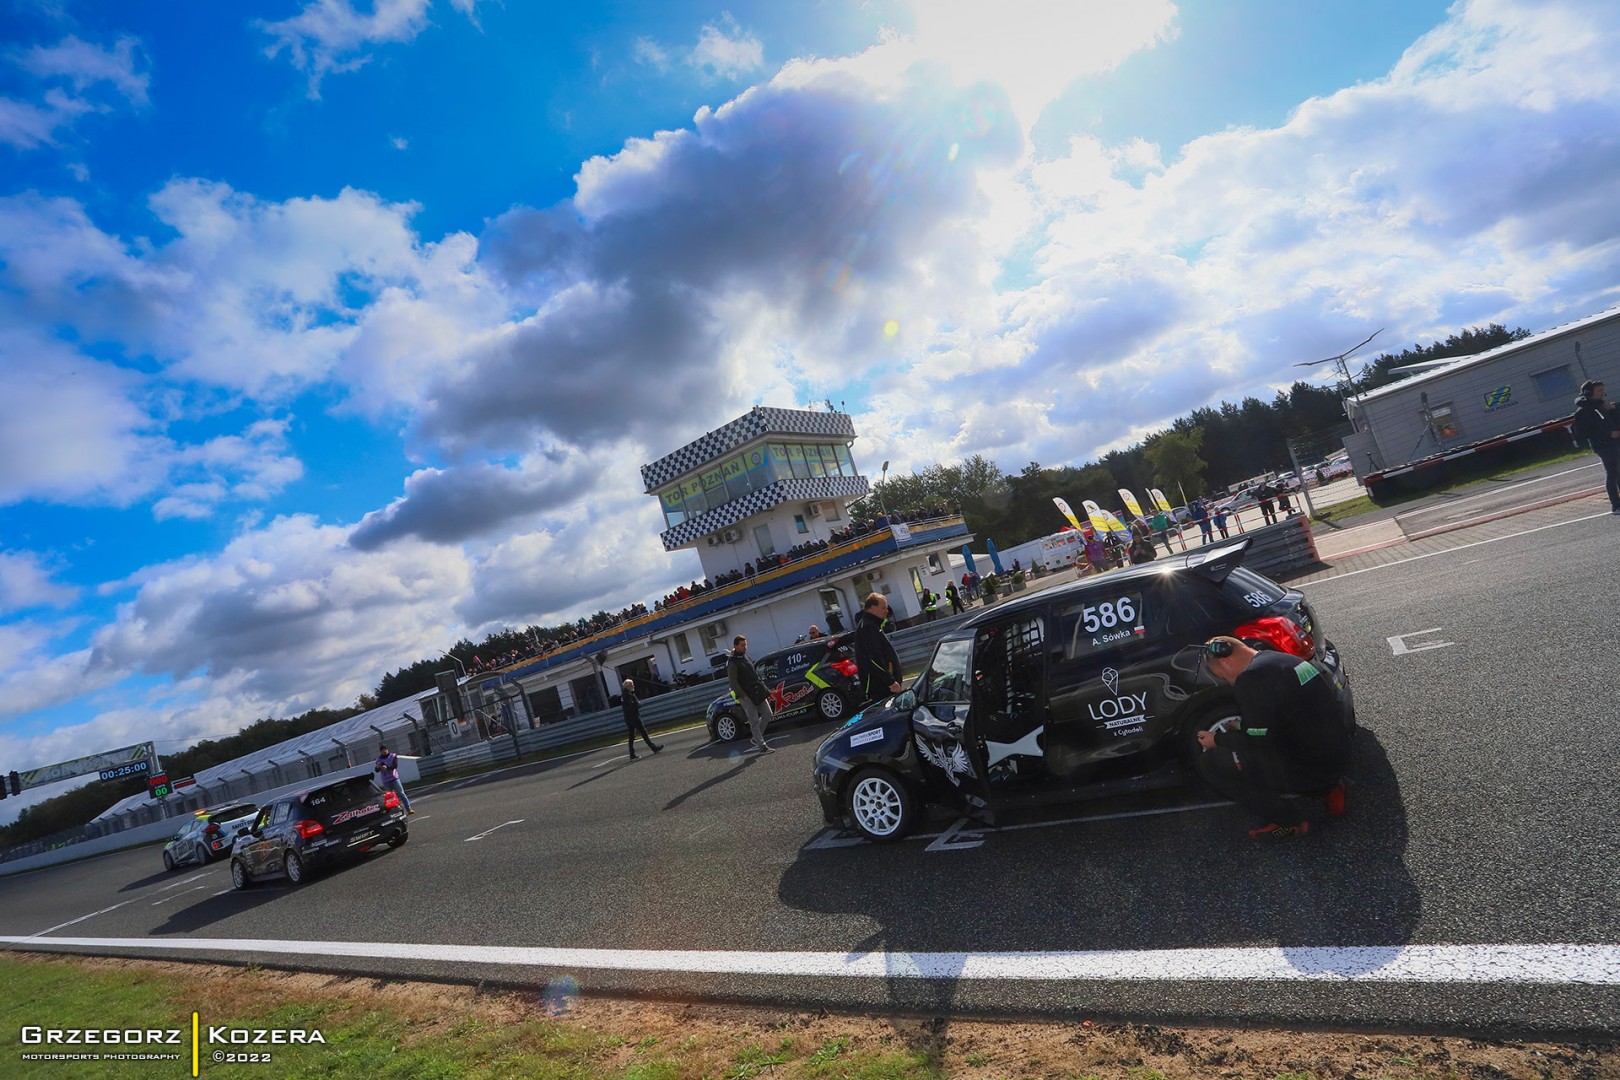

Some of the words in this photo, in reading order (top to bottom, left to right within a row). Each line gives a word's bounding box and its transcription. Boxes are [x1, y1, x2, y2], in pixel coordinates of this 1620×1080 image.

[772, 447, 793, 458] TOR
[665, 488, 689, 503] TOR
[1243, 590, 1273, 608] 586
[1083, 597, 1136, 633] 586
[1092, 637, 1101, 646] A.
[1103, 630, 1131, 643] Sówka
[787, 653, 801, 664] 110
[1087, 692, 1147, 721] LODY
[1108, 717, 1141, 727] NATURALNE
[101, 762, 147, 780] 00:25:00
[155, 787, 167, 796] 00
